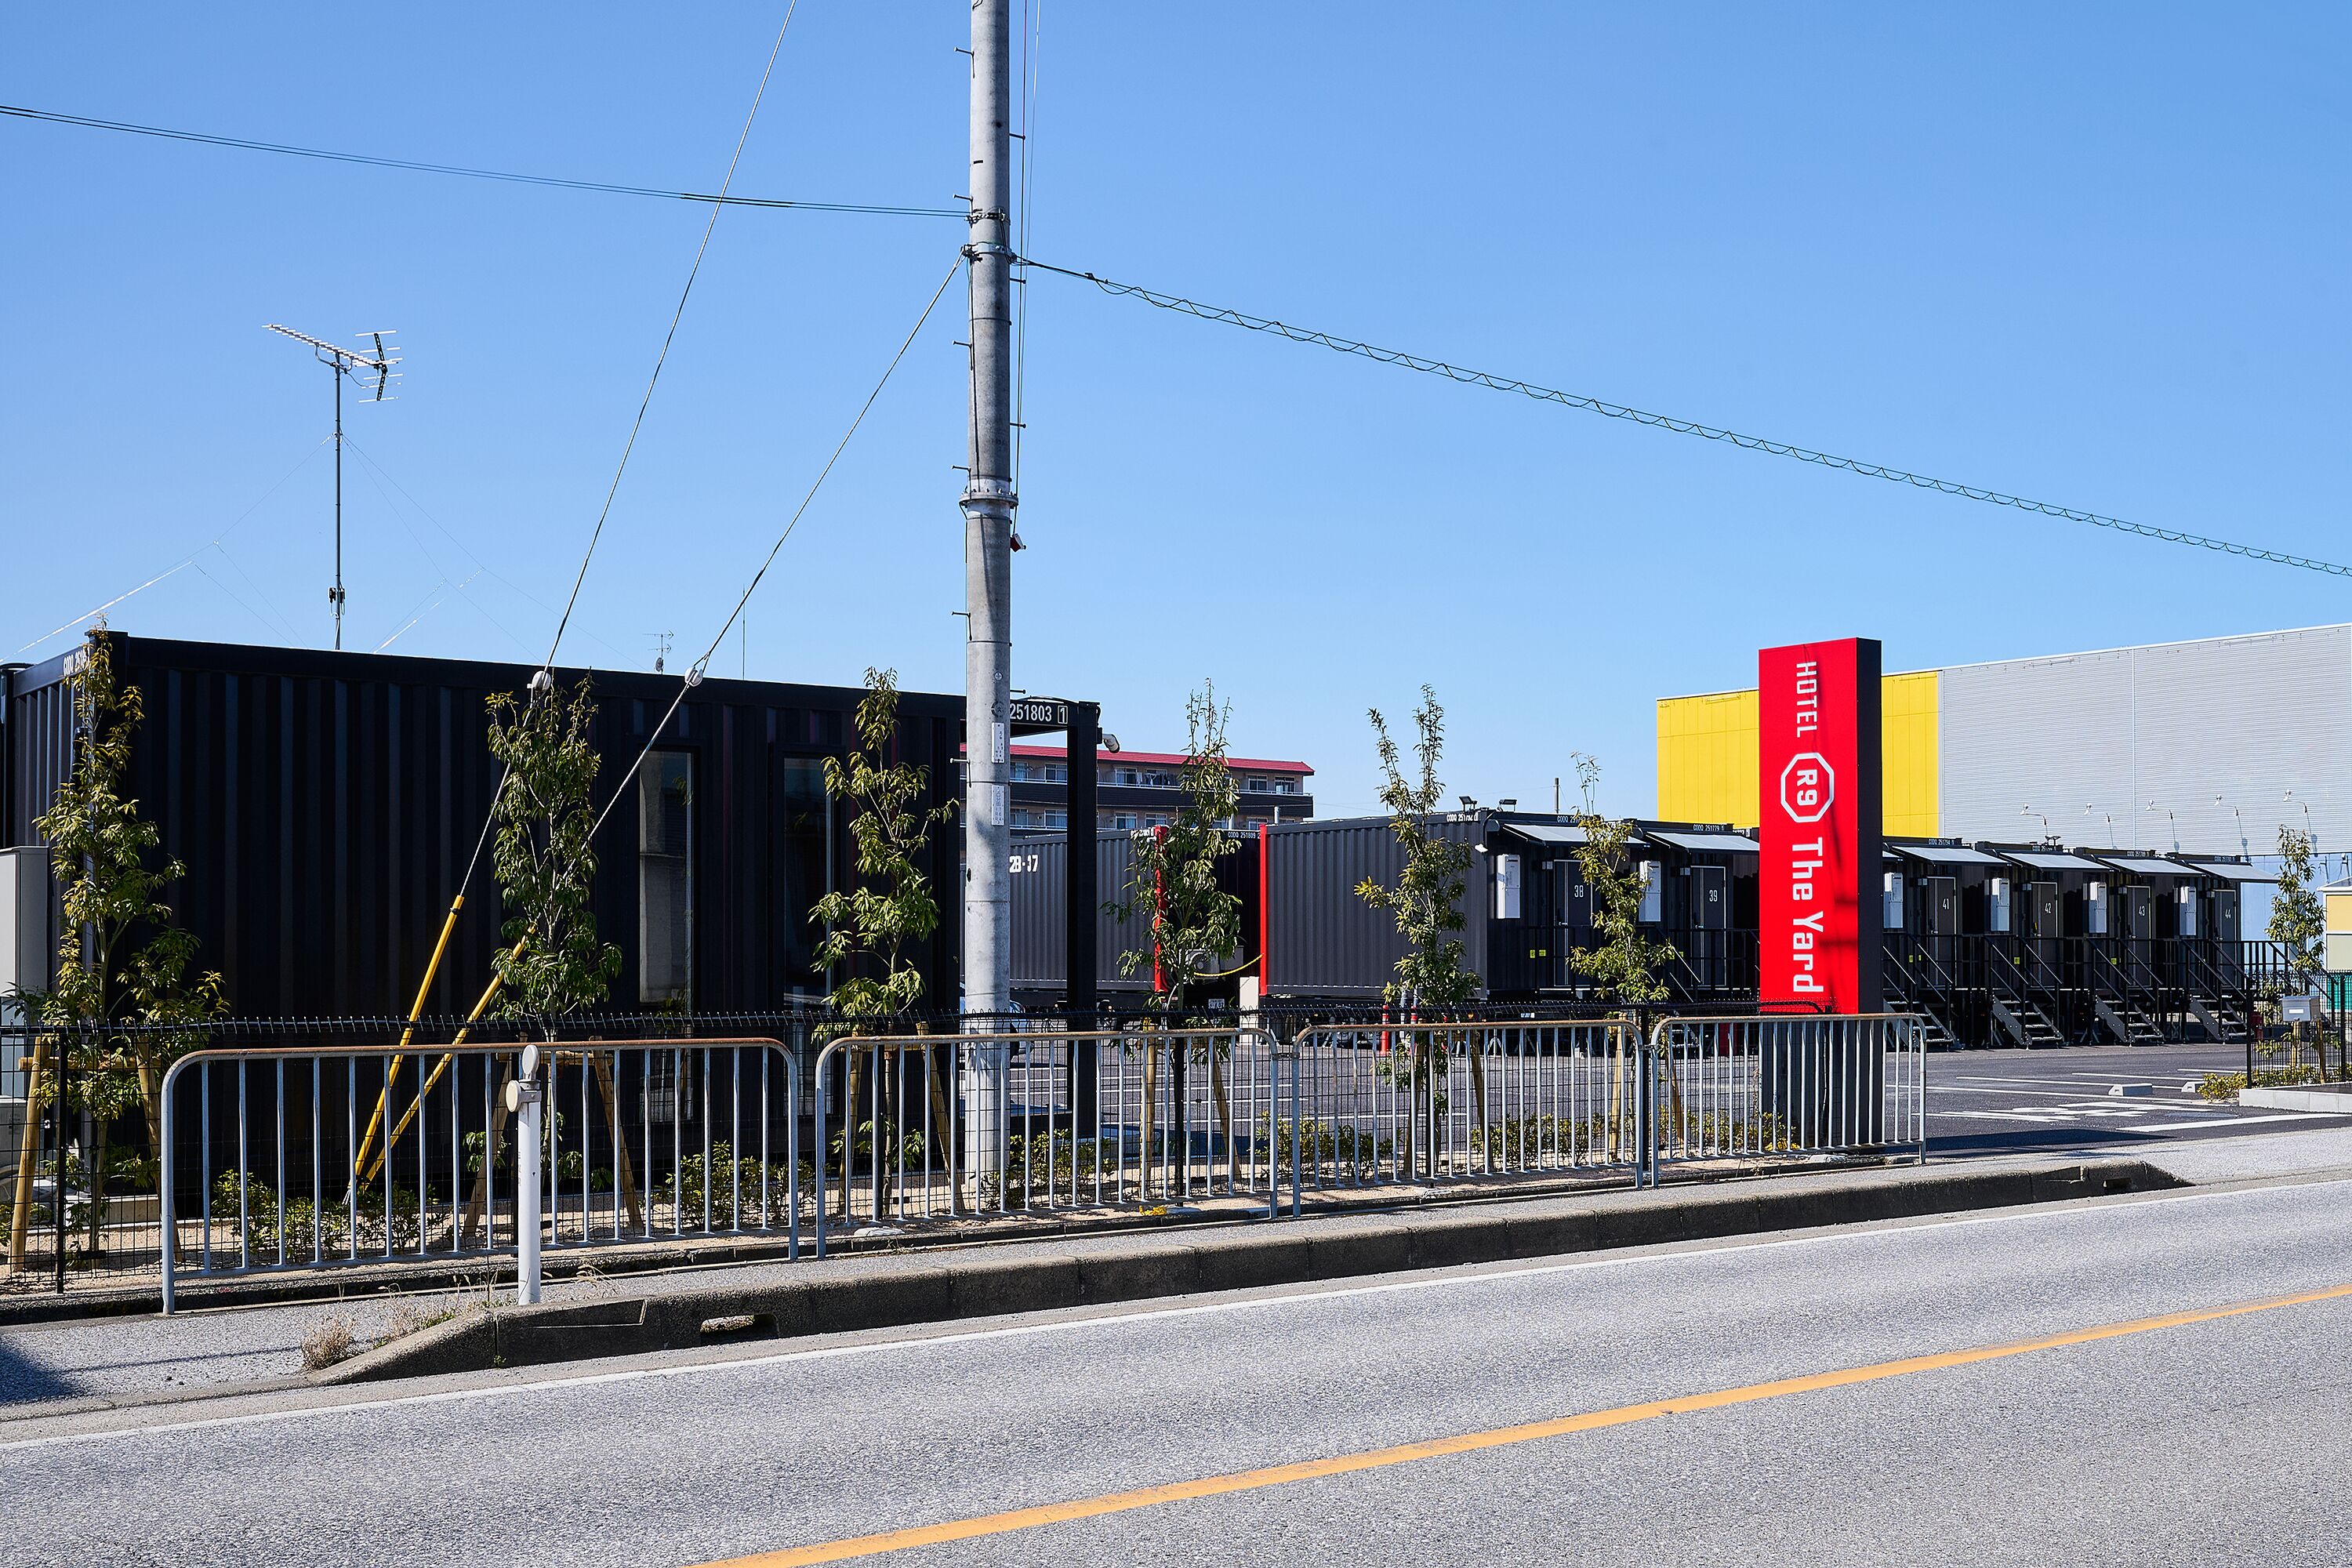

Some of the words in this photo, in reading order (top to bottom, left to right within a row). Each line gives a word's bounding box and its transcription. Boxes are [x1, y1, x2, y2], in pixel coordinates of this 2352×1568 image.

[1796, 662, 1817, 738] HOTEL
[1010, 703, 1051, 721] 251803
[1059, 706, 1066, 723] 1
[1796, 768, 1817, 806] R9
[1010, 855, 1038, 873] 28-37
[1792, 837, 1823, 900] The
[1574, 884, 1583, 897] 38
[1709, 890, 1718, 902] 39
[1942, 898, 1950, 909] 41
[2045, 903, 2052, 915] 42
[2138, 906, 2146, 917] 43
[2224, 909, 2230, 920] 44
[1792, 910, 1824, 993] Yard
